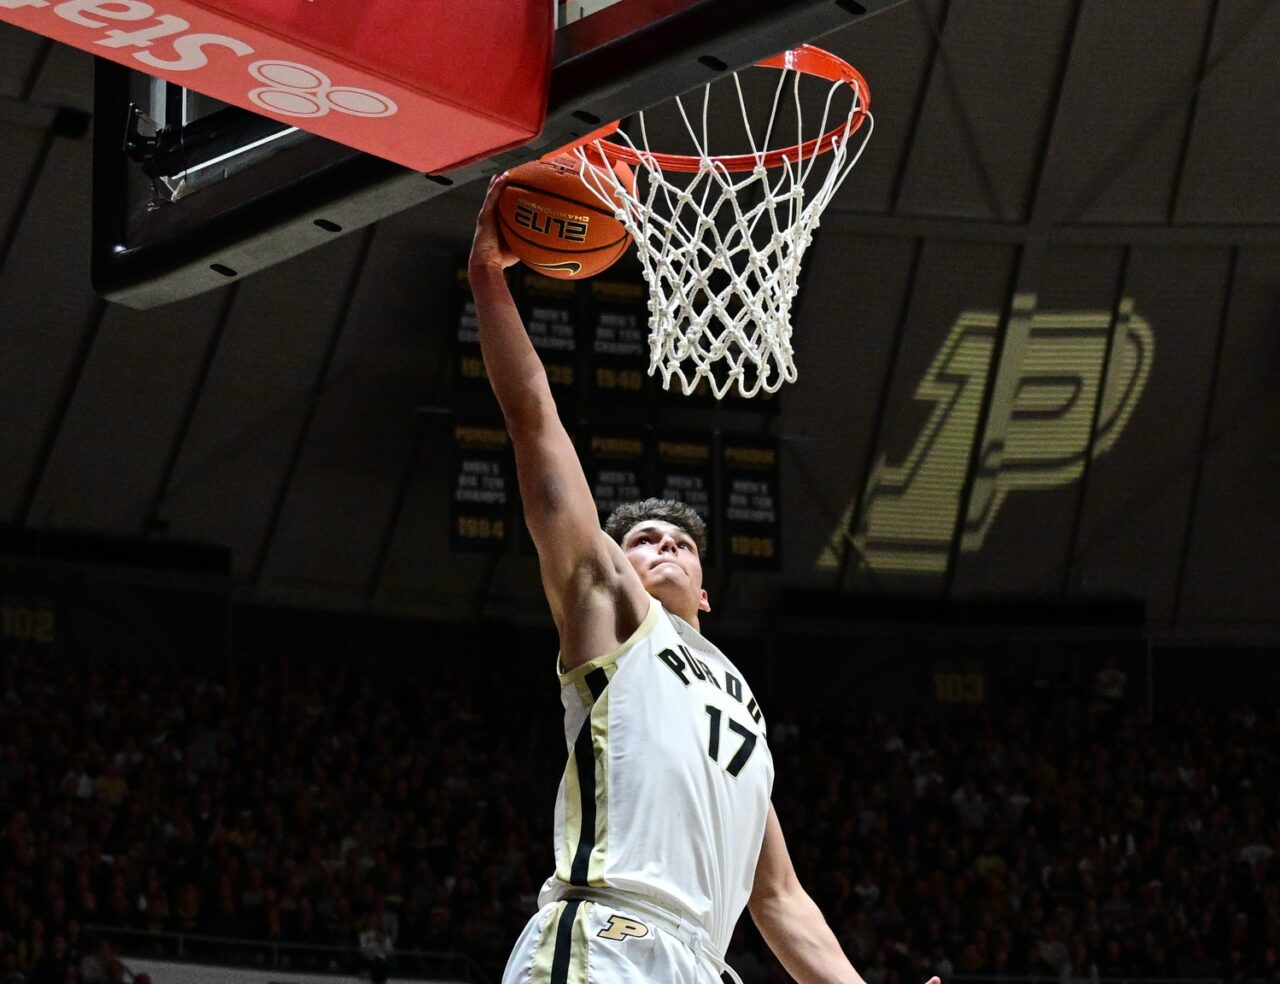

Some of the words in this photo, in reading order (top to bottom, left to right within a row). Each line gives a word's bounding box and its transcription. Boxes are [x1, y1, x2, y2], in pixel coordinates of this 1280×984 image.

[514, 204, 589, 243] ELITE
[655, 644, 767, 740] PURDU
[705, 704, 758, 780] 17
[597, 914, 649, 941] P
